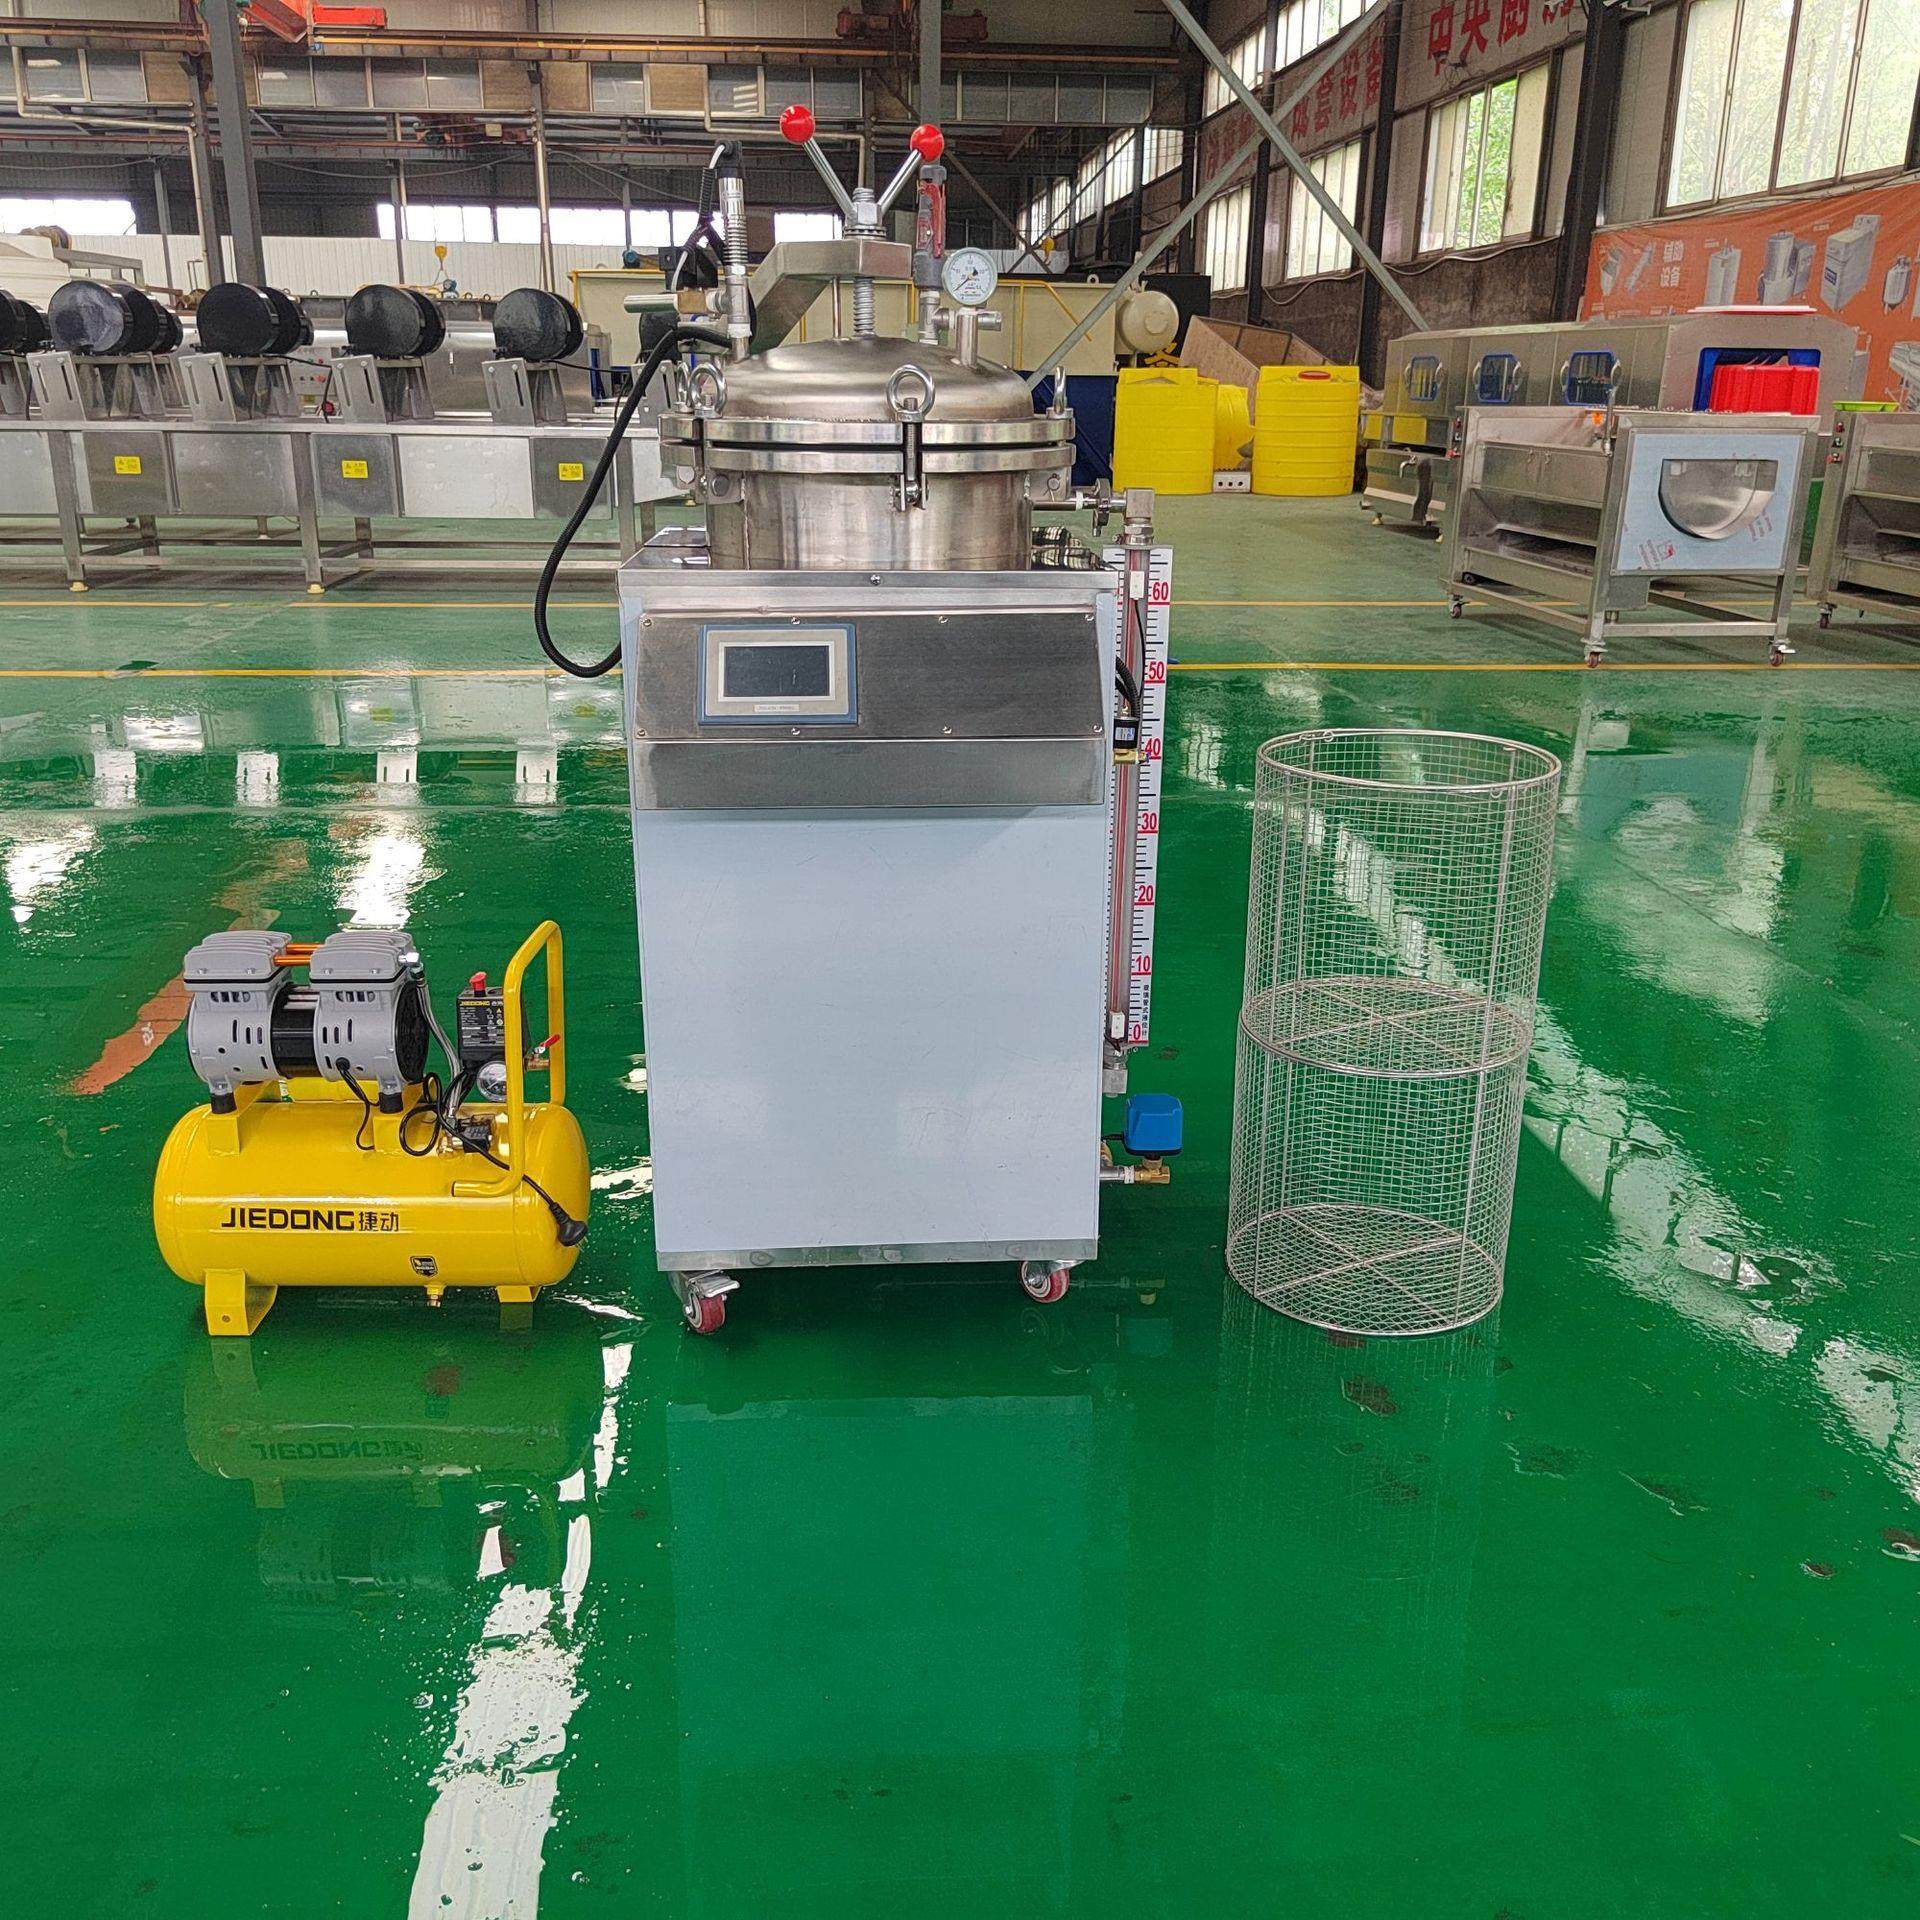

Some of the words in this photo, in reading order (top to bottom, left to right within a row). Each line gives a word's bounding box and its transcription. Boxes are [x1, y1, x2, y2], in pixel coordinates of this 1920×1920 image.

[1152, 582, 1168, 600] 60
[1148, 664, 1164, 680] 50
[1145, 738, 1161, 757] 40
[1141, 813, 1157, 830] 30
[1138, 885, 1154, 902] 20
[1135, 956, 1151, 972] 10
[1133, 1024, 1141, 1040] 0
[221, 1207, 355, 1231] JIEDONG
[358, 1211, 399, 1232] 捷动
